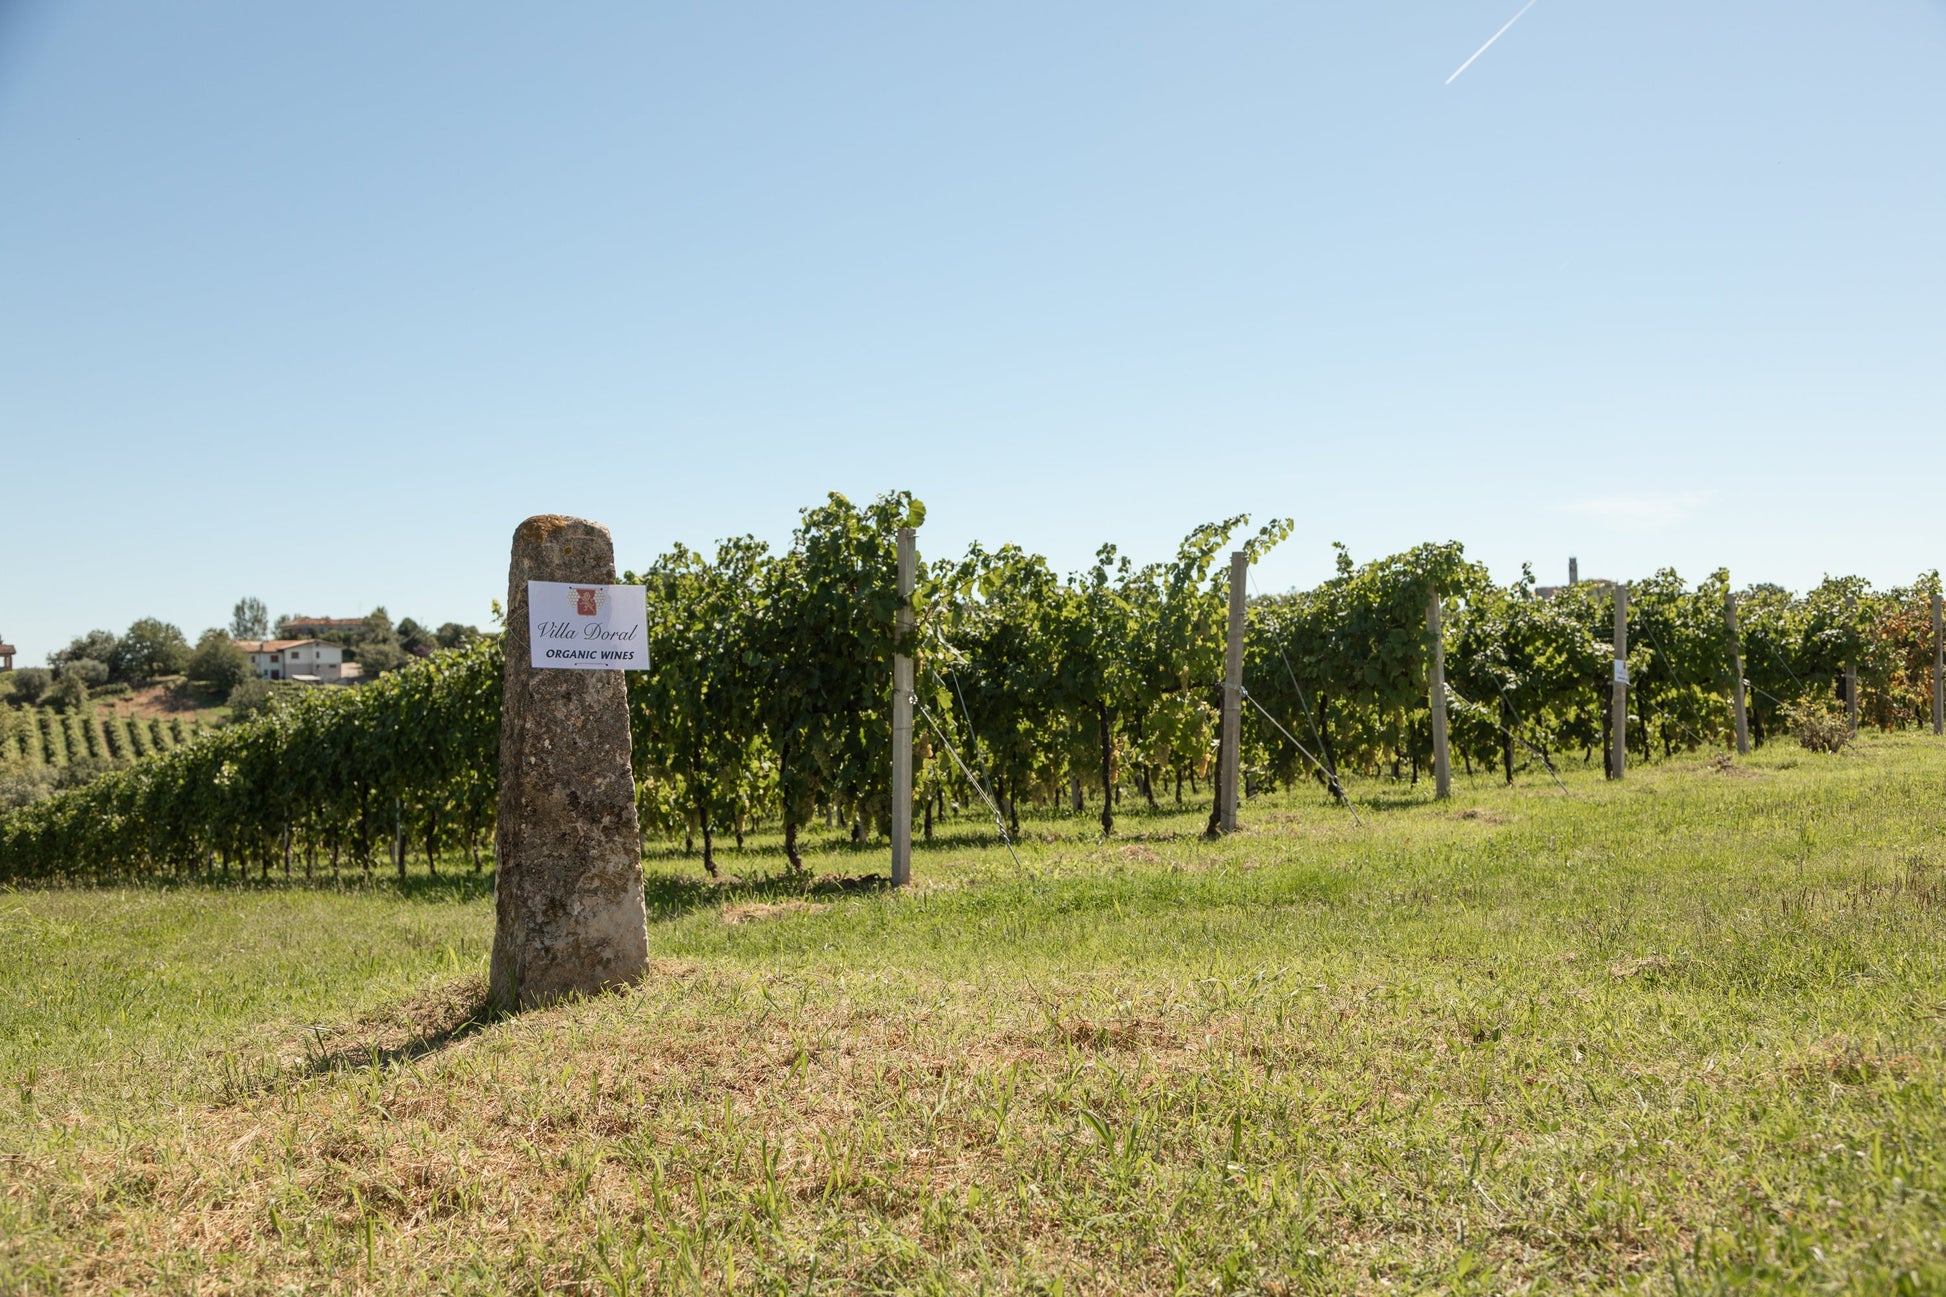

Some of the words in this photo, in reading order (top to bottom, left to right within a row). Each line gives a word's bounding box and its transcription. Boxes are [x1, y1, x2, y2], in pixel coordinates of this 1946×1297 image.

[537, 621, 577, 639] Villa
[583, 622, 638, 641] Doral
[545, 649, 597, 659] ORGANIC
[600, 651, 634, 660] WINES
